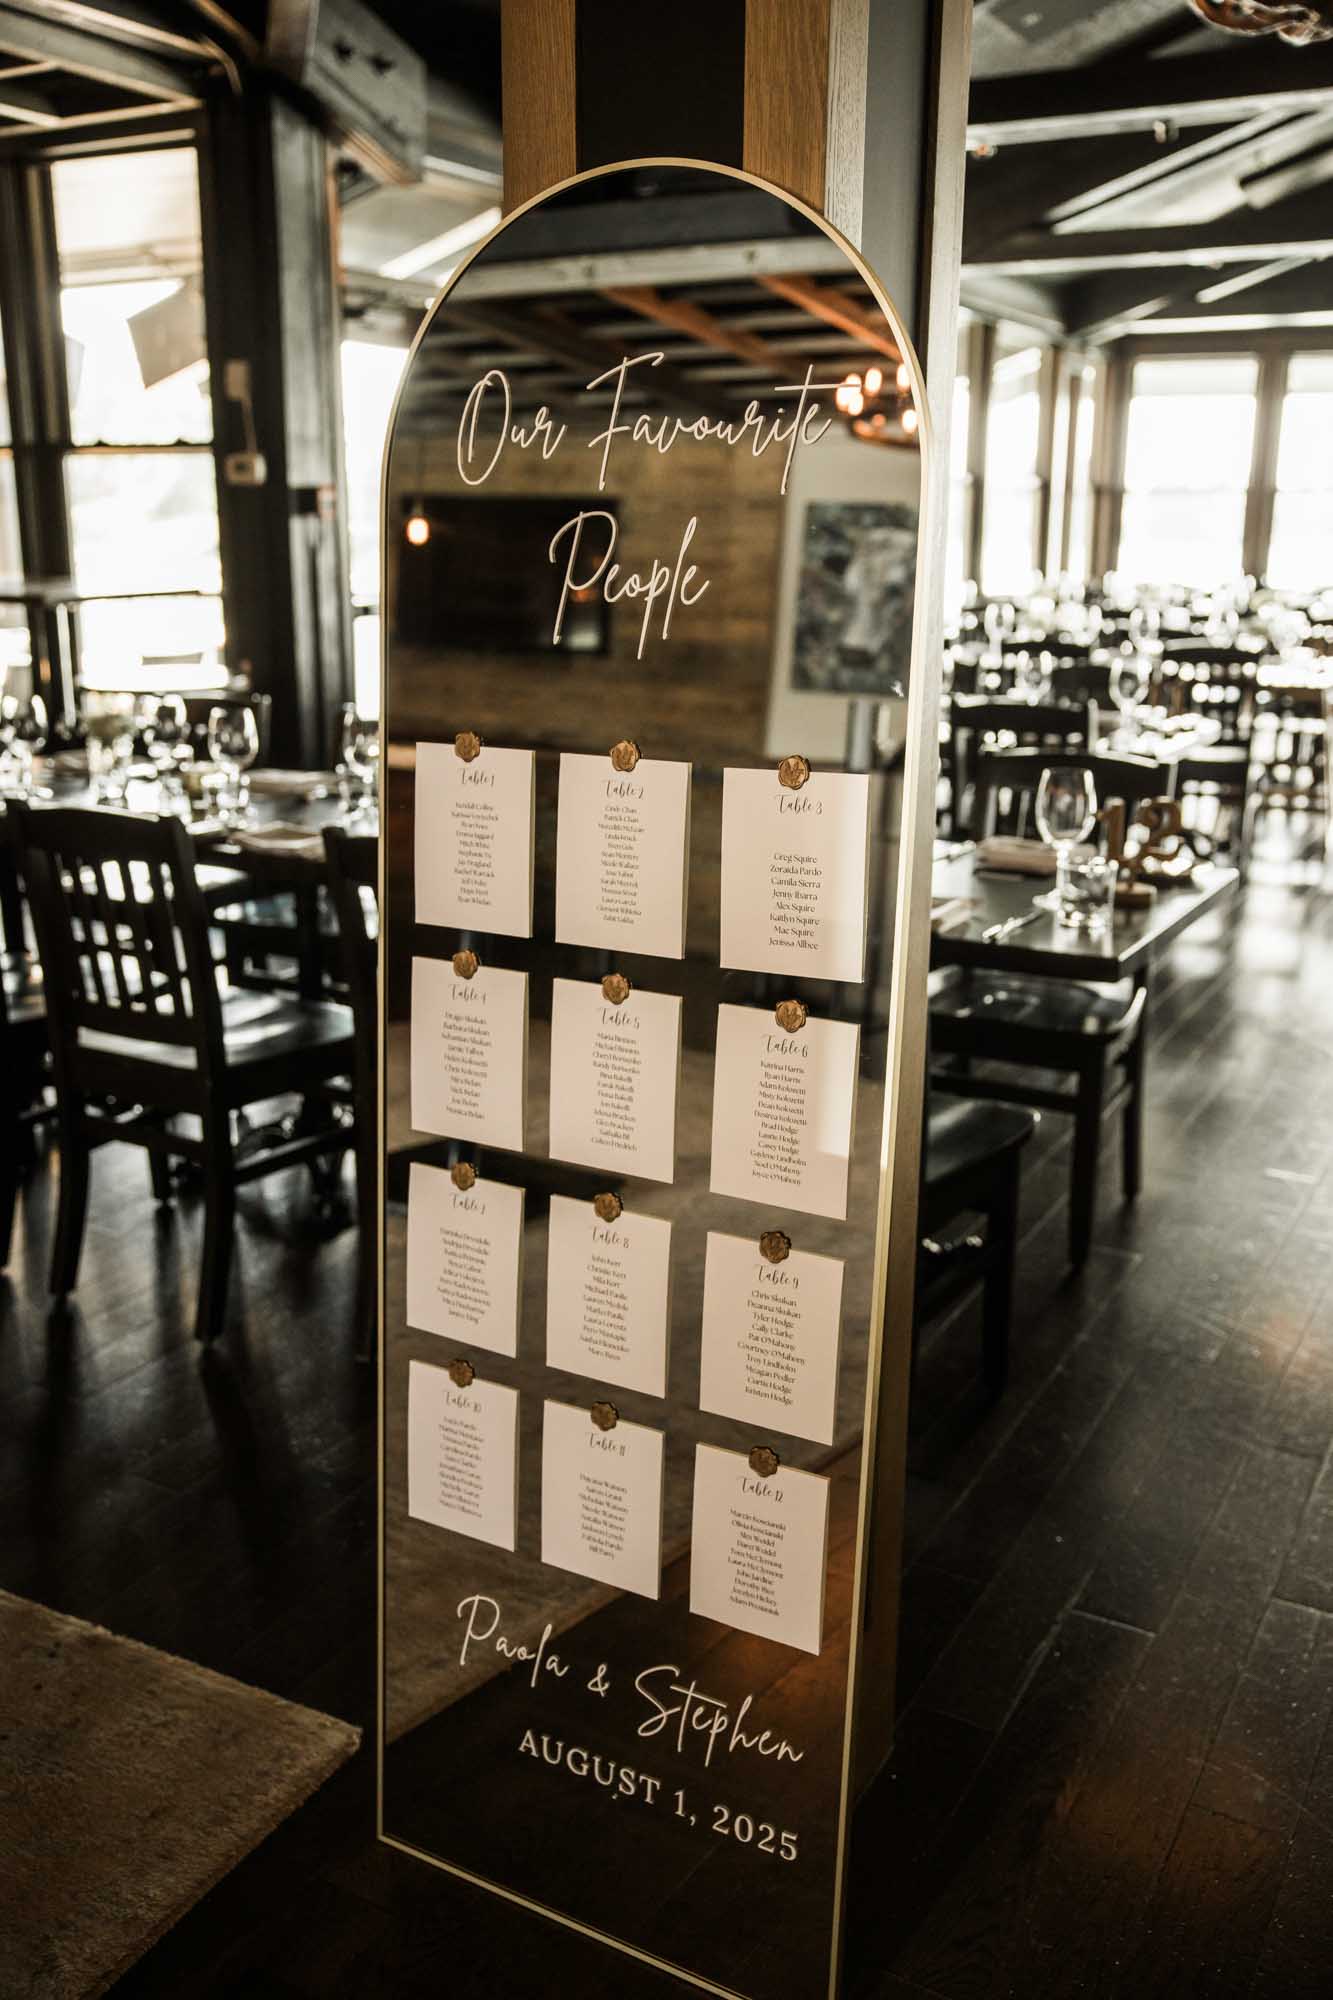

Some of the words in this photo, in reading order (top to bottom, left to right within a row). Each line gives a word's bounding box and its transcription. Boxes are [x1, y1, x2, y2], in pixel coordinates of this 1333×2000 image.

[456, 369, 568, 486] Our
[586, 352, 862, 495] Favourite
[547, 511, 711, 660] People
[458, 766, 490, 786] Table
[602, 780, 636, 798] Table
[775, 793, 812, 815] Table
[815, 801, 823, 815] 3
[793, 855, 817, 864] Squire
[798, 879, 821, 889] Sierra
[791, 903, 815, 913] Squire
[796, 915, 820, 926] Squire
[791, 927, 814, 938] Squire
[598, 1008, 631, 1026] Table
[763, 1034, 799, 1056] Table
[802, 1045, 808, 1058] 6
[754, 1264, 789, 1285] Table
[793, 1276, 799, 1288] 9
[737, 1477, 772, 1497] Table
[775, 1489, 783, 1503] 12
[457, 1594, 568, 1688] Paola
[587, 1663, 611, 1697] &
[635, 1665, 804, 1768] Stephen
[518, 1729, 661, 1805] AUGUST
[673, 1789, 696, 1827] 1,
[711, 1805, 799, 1862] 2025
